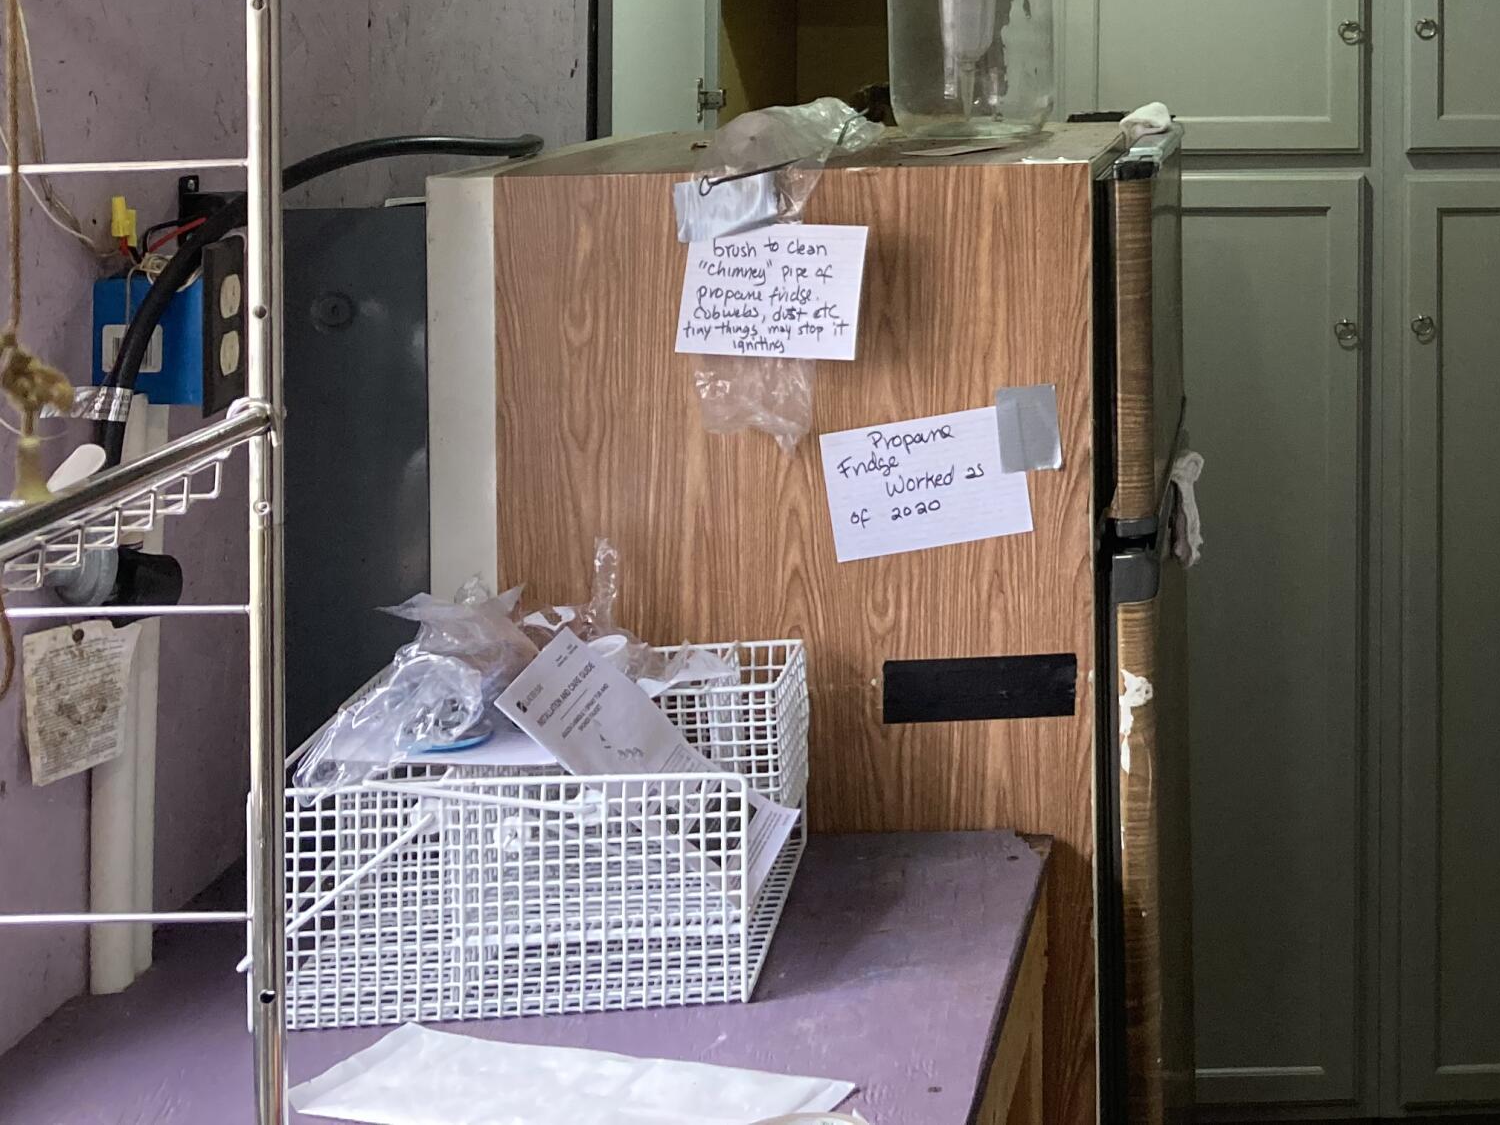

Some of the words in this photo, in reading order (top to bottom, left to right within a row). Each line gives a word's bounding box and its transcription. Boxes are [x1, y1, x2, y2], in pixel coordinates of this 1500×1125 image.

[713, 237, 757, 257] brush
[764, 236, 780, 252] to
[782, 265, 808, 283] pipe
[815, 264, 833, 284] of
[697, 285, 762, 306] propane
[772, 306, 808, 322] dust
[683, 321, 711, 341] tiny
[768, 326, 792, 340] may
[798, 321, 824, 342] stop
[833, 320, 849, 336] it
[733, 335, 785, 354] igniting
[867, 425, 955, 454] Propane
[837, 451, 899, 478] Fridge
[885, 465, 955, 497] Worked
[965, 463, 985, 479] as
[850, 508, 871, 528] of
[891, 499, 941, 521] 2020
